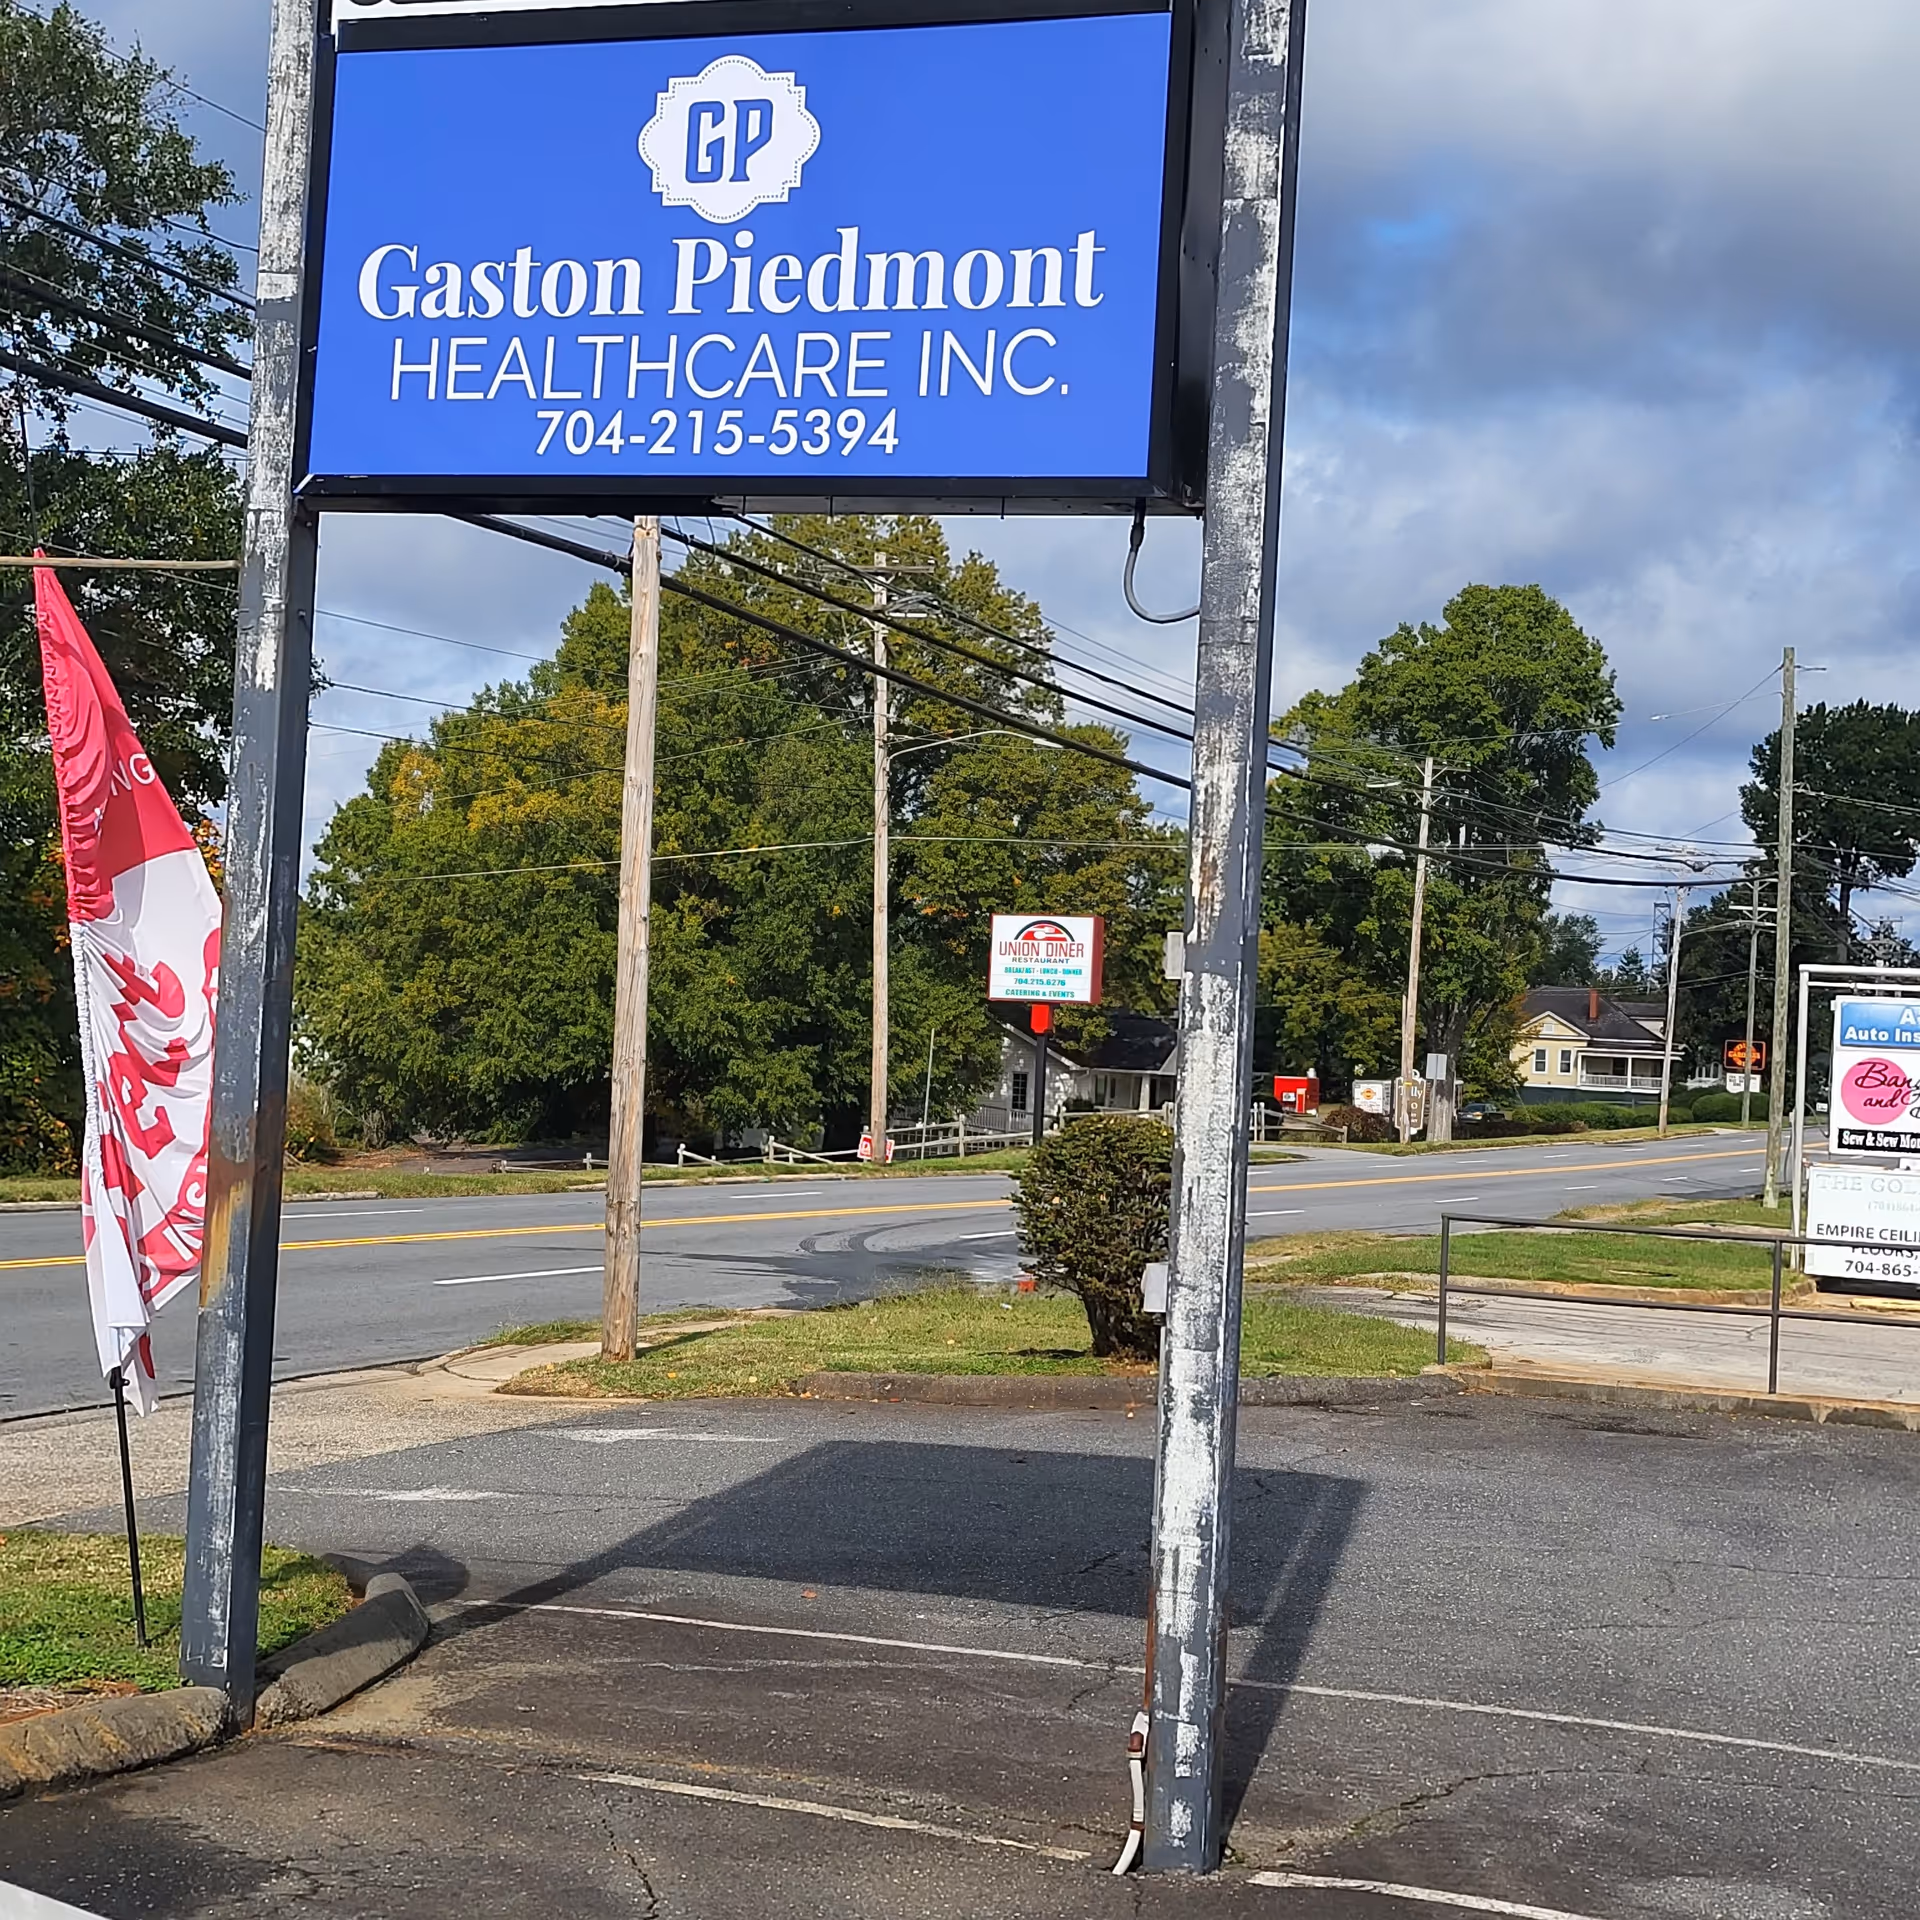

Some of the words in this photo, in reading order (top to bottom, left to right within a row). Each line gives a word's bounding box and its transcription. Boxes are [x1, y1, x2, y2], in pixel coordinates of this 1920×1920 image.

[685, 98, 773, 183] GP
[358, 243, 645, 320] Gaston
[667, 226, 1106, 315] Piedmont
[390, 331, 892, 401] HEALTHCARE
[918, 327, 1069, 398] INC.
[535, 407, 900, 456] 704-215-5394
[999, 941, 1040, 956] UNION
[1046, 942, 1084, 958] DINER
[1011, 956, 1070, 964] RESTAURANT
[1005, 988, 1040, 996] CATERING
[1049, 990, 1075, 998] EVENTS
[1844, 1026, 1889, 1041] Auto
[1863, 1088, 1902, 1108] and
[1842, 1130, 1865, 1145] Sew
[1865, 1131, 1875, 1147] &
[1876, 1132, 1899, 1148] Sew
[1816, 1174, 1862, 1191] THE
[1816, 1223, 1874, 1239] EMPIRE
[1879, 1228, 1920, 1242] CEILI
[1845, 1259, 1920, 1277] 704-865-
